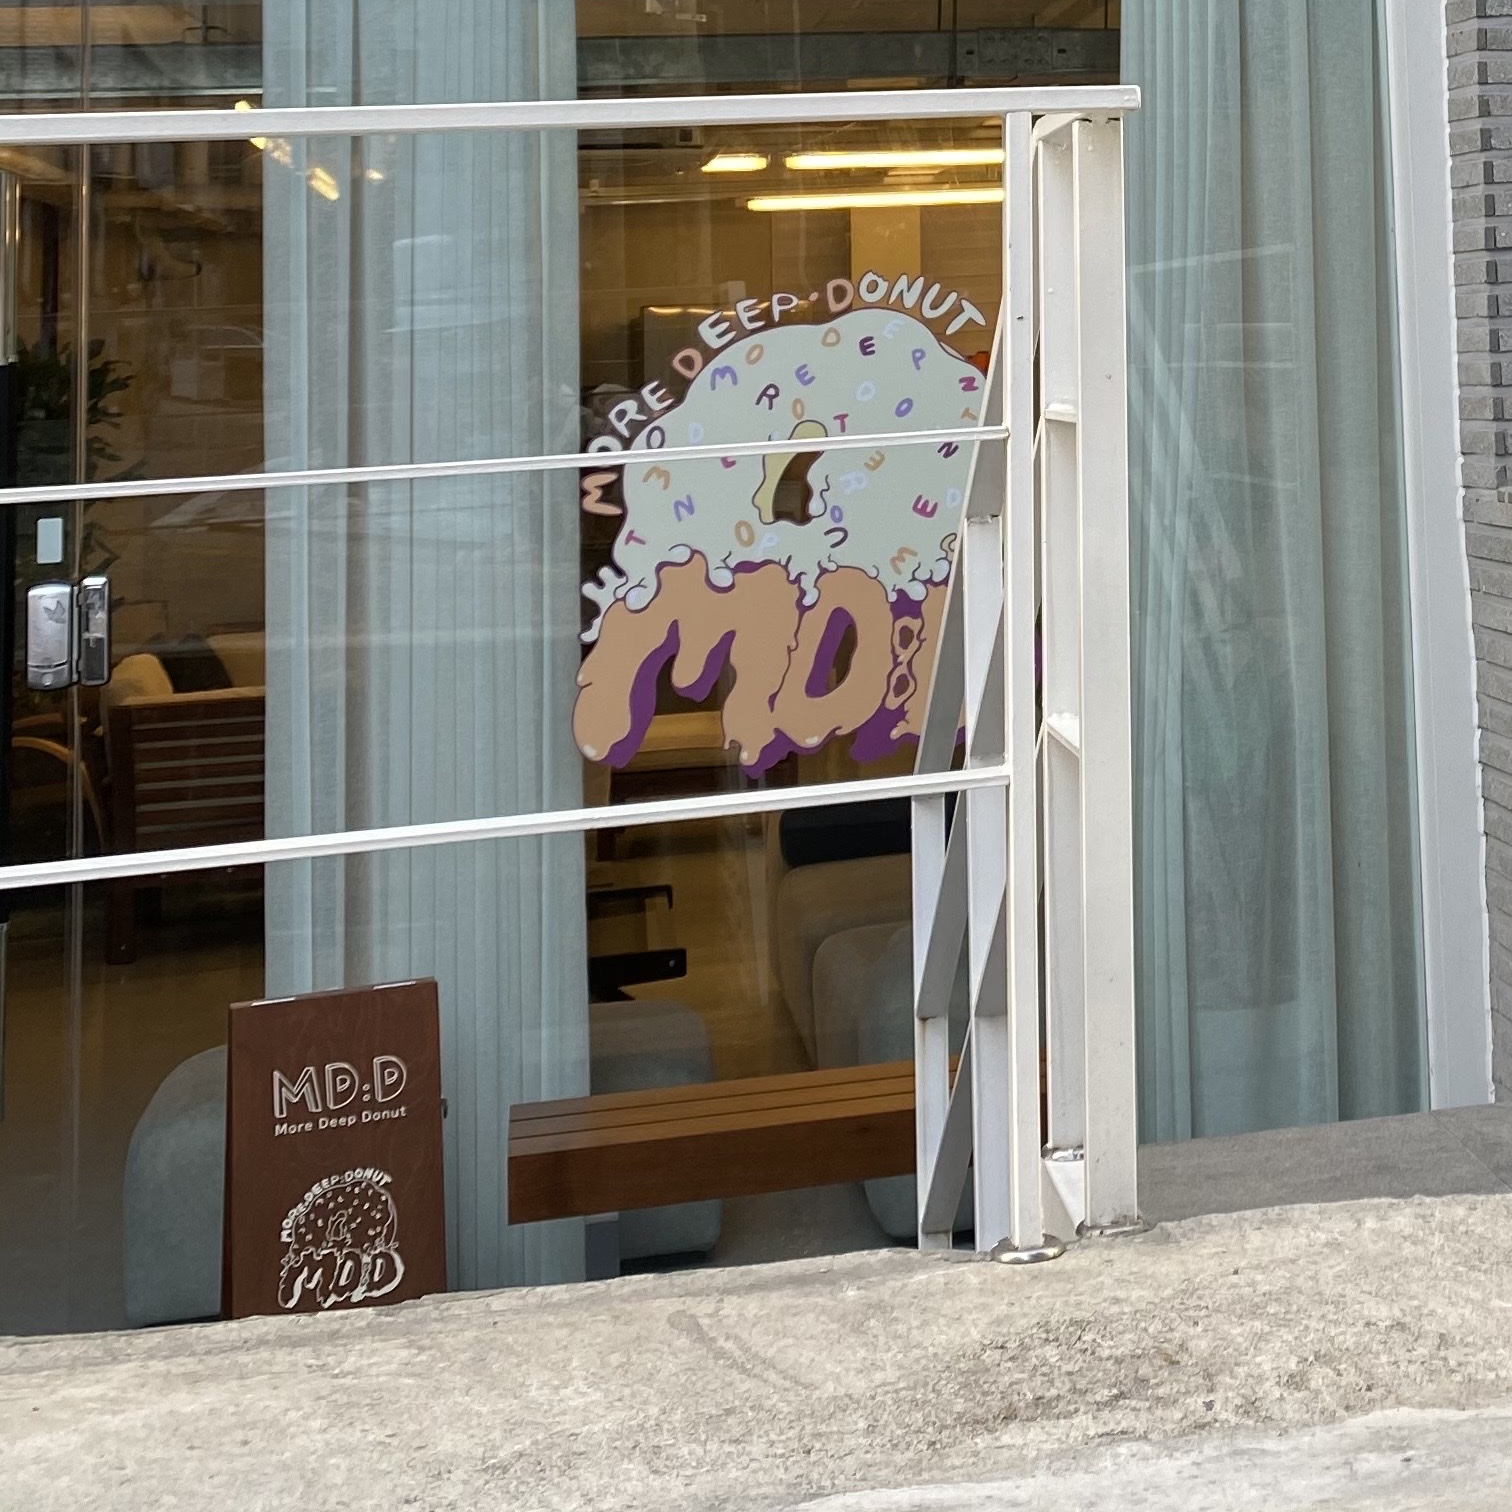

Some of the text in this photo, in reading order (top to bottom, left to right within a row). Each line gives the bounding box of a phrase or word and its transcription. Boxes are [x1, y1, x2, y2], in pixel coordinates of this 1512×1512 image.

[274, 1105, 408, 1137] More Deep Donut
